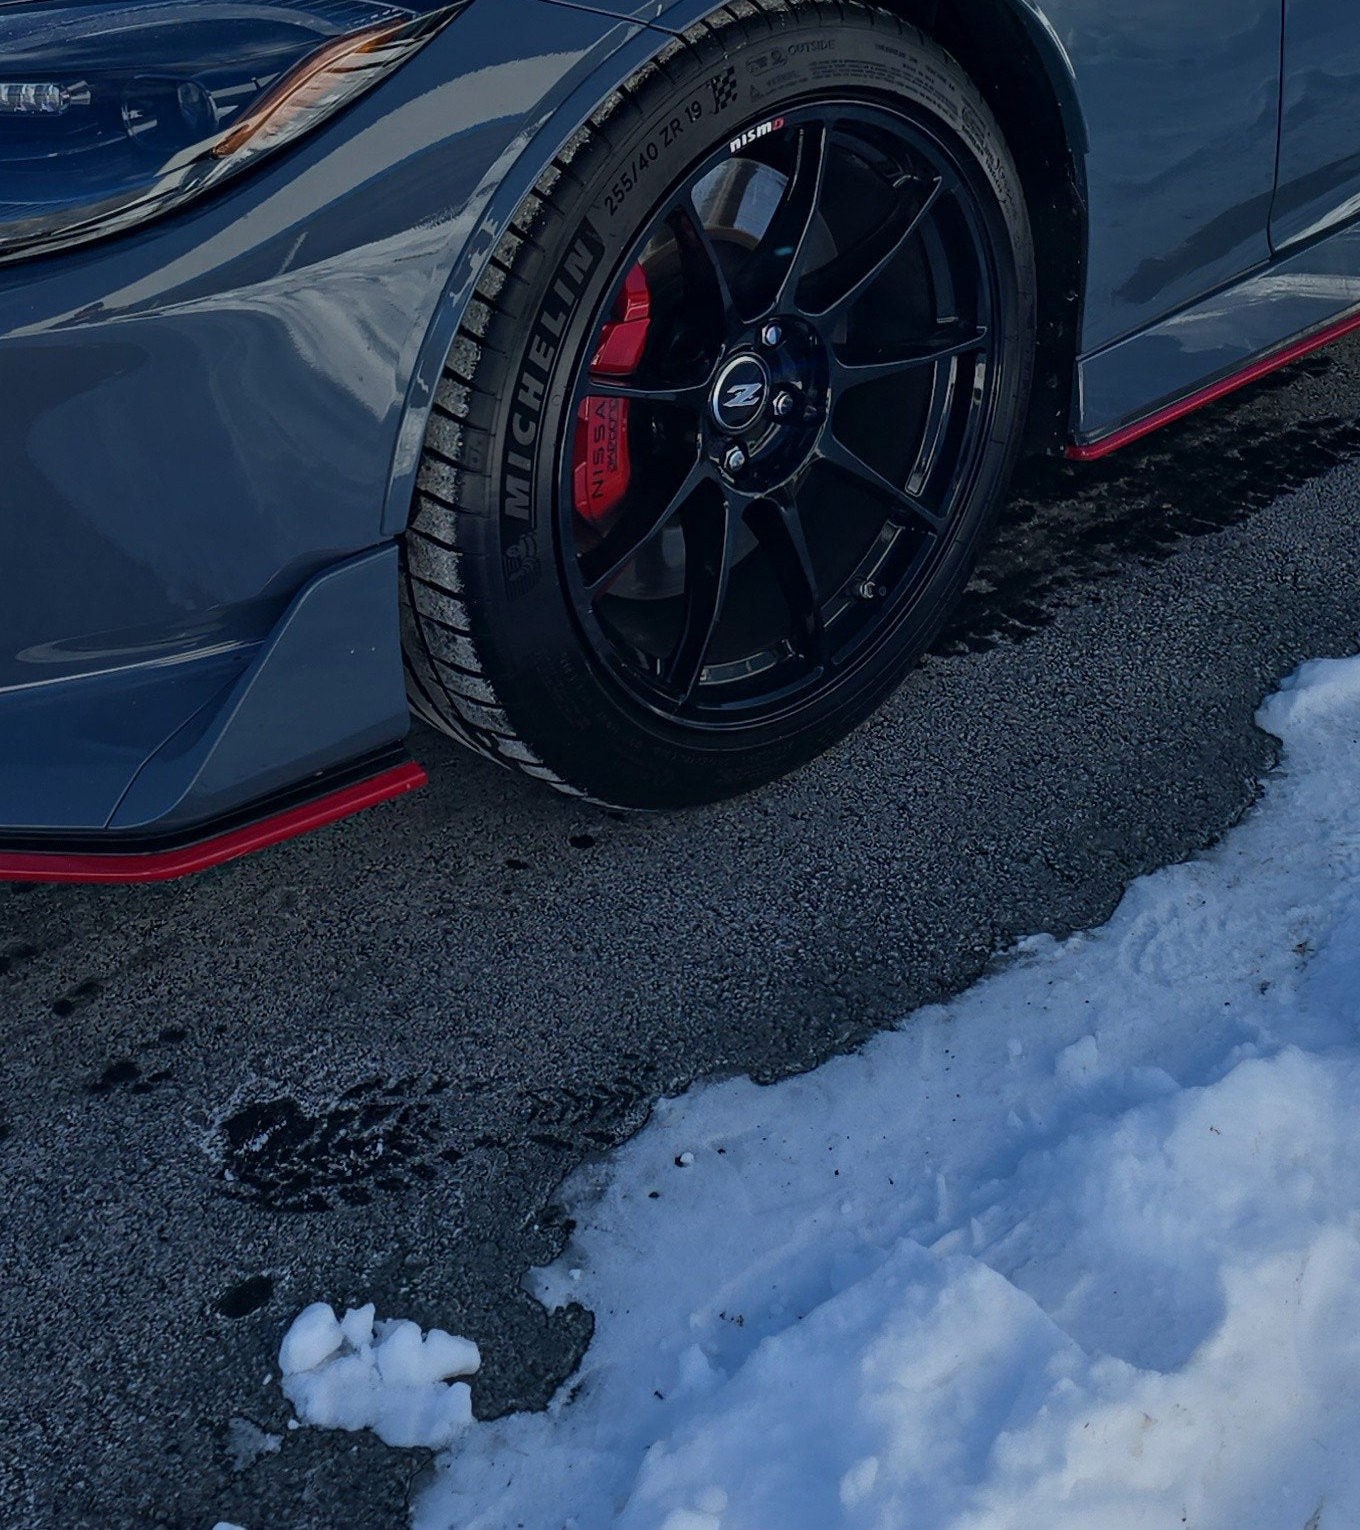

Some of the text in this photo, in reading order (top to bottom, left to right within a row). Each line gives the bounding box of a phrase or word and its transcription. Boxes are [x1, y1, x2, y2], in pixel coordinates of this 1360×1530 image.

[787, 38, 836, 56] OUTSIDE
[604, 100, 702, 216] 255/40 ZR 19
[730, 117, 785, 153] nismo
[505, 237, 596, 521] MICHELIN
[591, 396, 606, 499] NISSA
